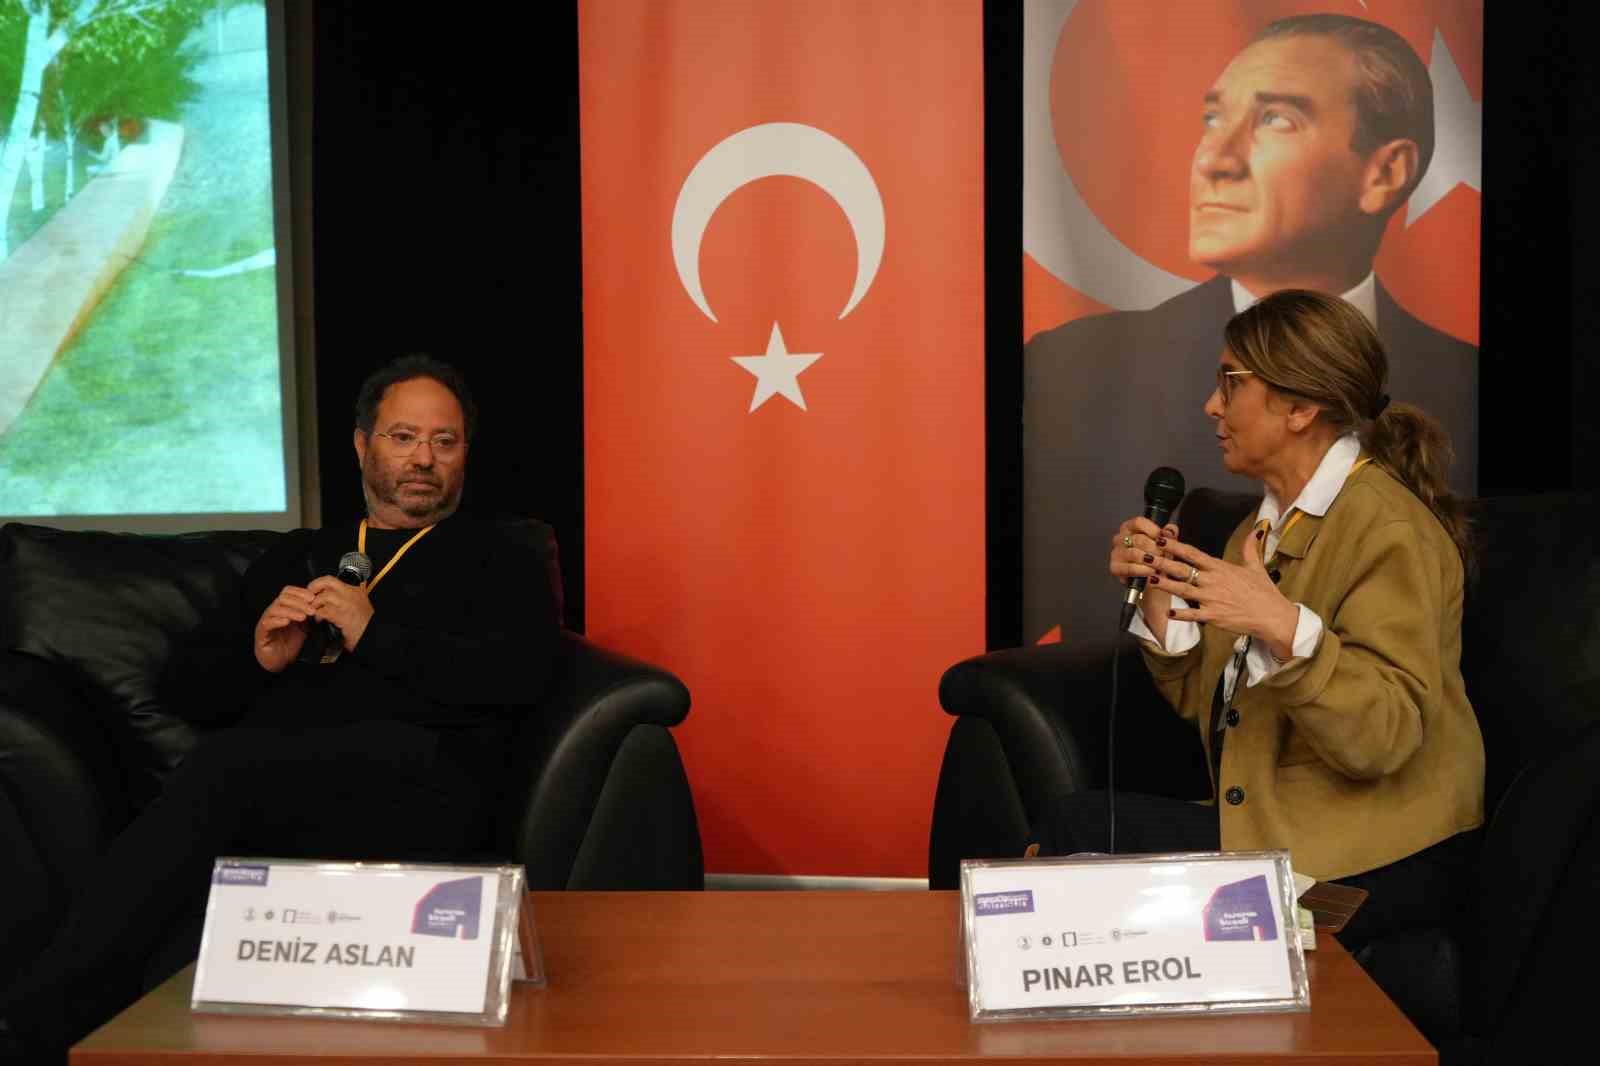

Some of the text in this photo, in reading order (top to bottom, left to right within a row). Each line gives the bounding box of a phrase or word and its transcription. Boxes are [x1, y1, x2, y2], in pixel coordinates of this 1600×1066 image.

[237, 936, 415, 968] DENİZ ASLAN
[1023, 956, 1202, 992] PINAR EROL
